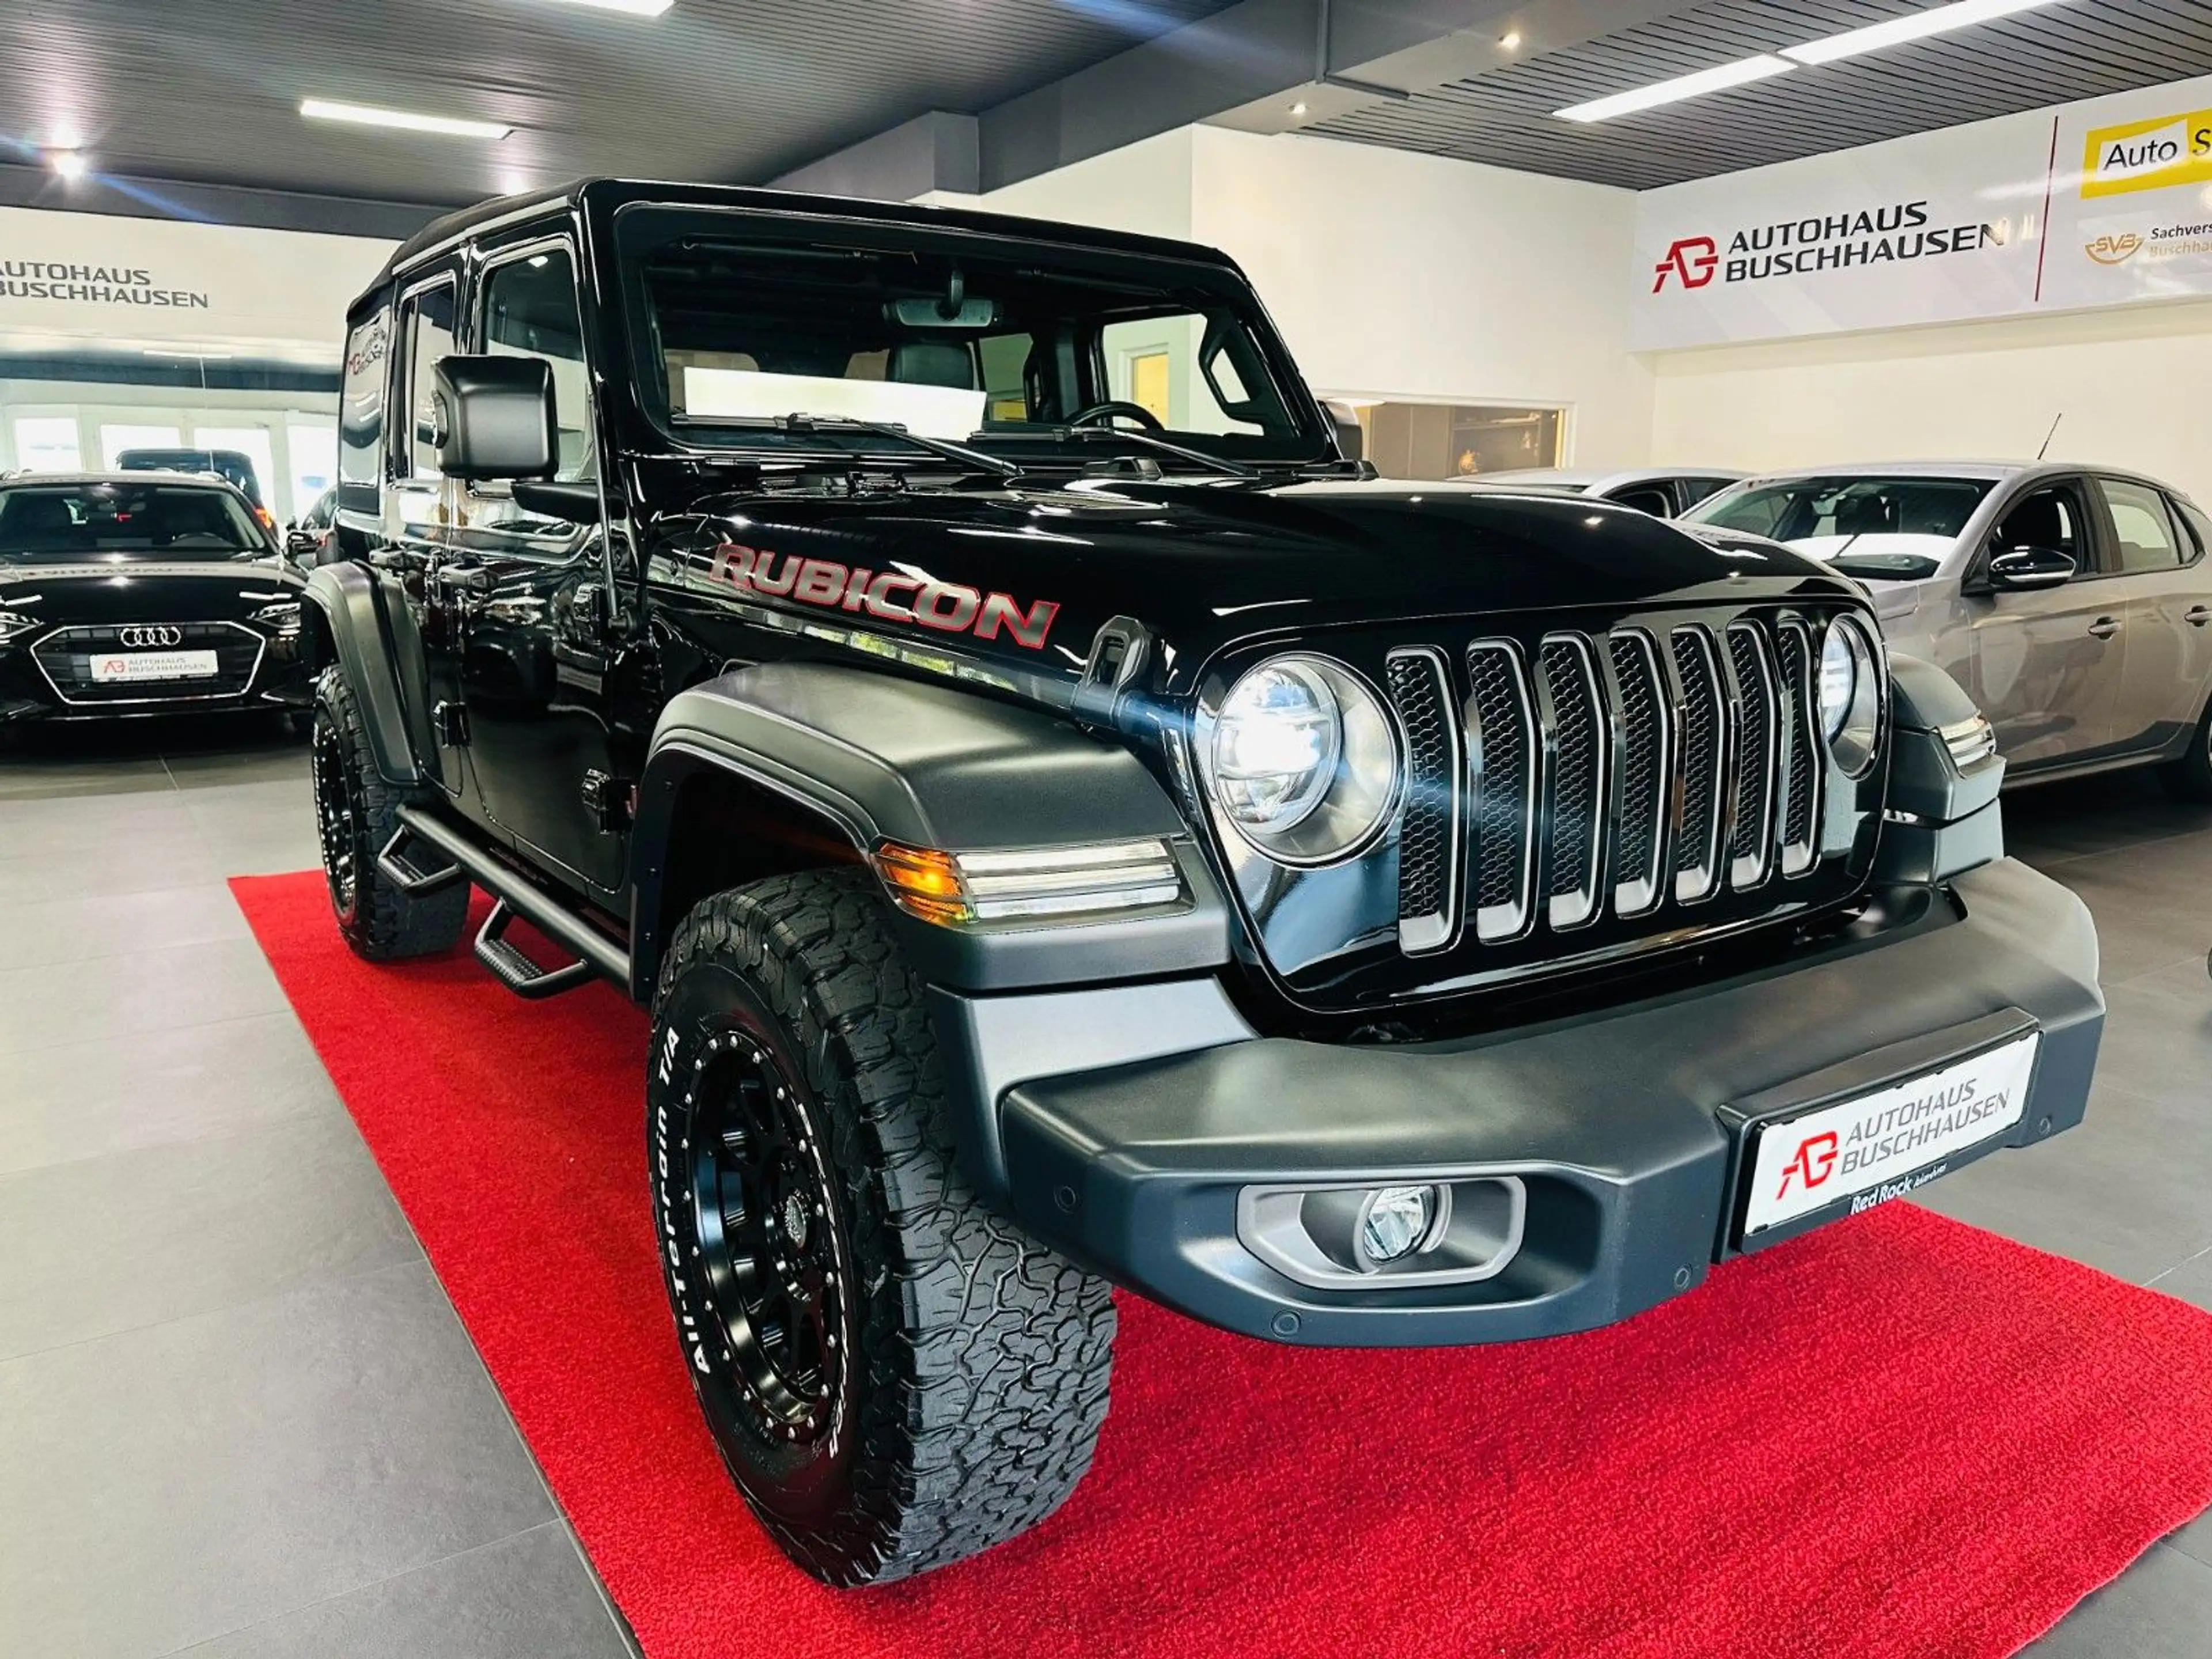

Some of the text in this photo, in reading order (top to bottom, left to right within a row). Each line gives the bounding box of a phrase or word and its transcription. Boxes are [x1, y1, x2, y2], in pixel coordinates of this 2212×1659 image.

[2103, 139, 2178, 171] Auto
[1725, 222, 2005, 283] BUSCHHAUSEN
[1728, 200, 1927, 254] AUTOHAUS
[0, 261, 151, 286] UTOHAUS
[708, 543, 1061, 650] RUBICON
[1840, 1088, 2010, 1176] BUSCHHAUSEN
[1845, 1078, 1978, 1146] AUTOHAUS
